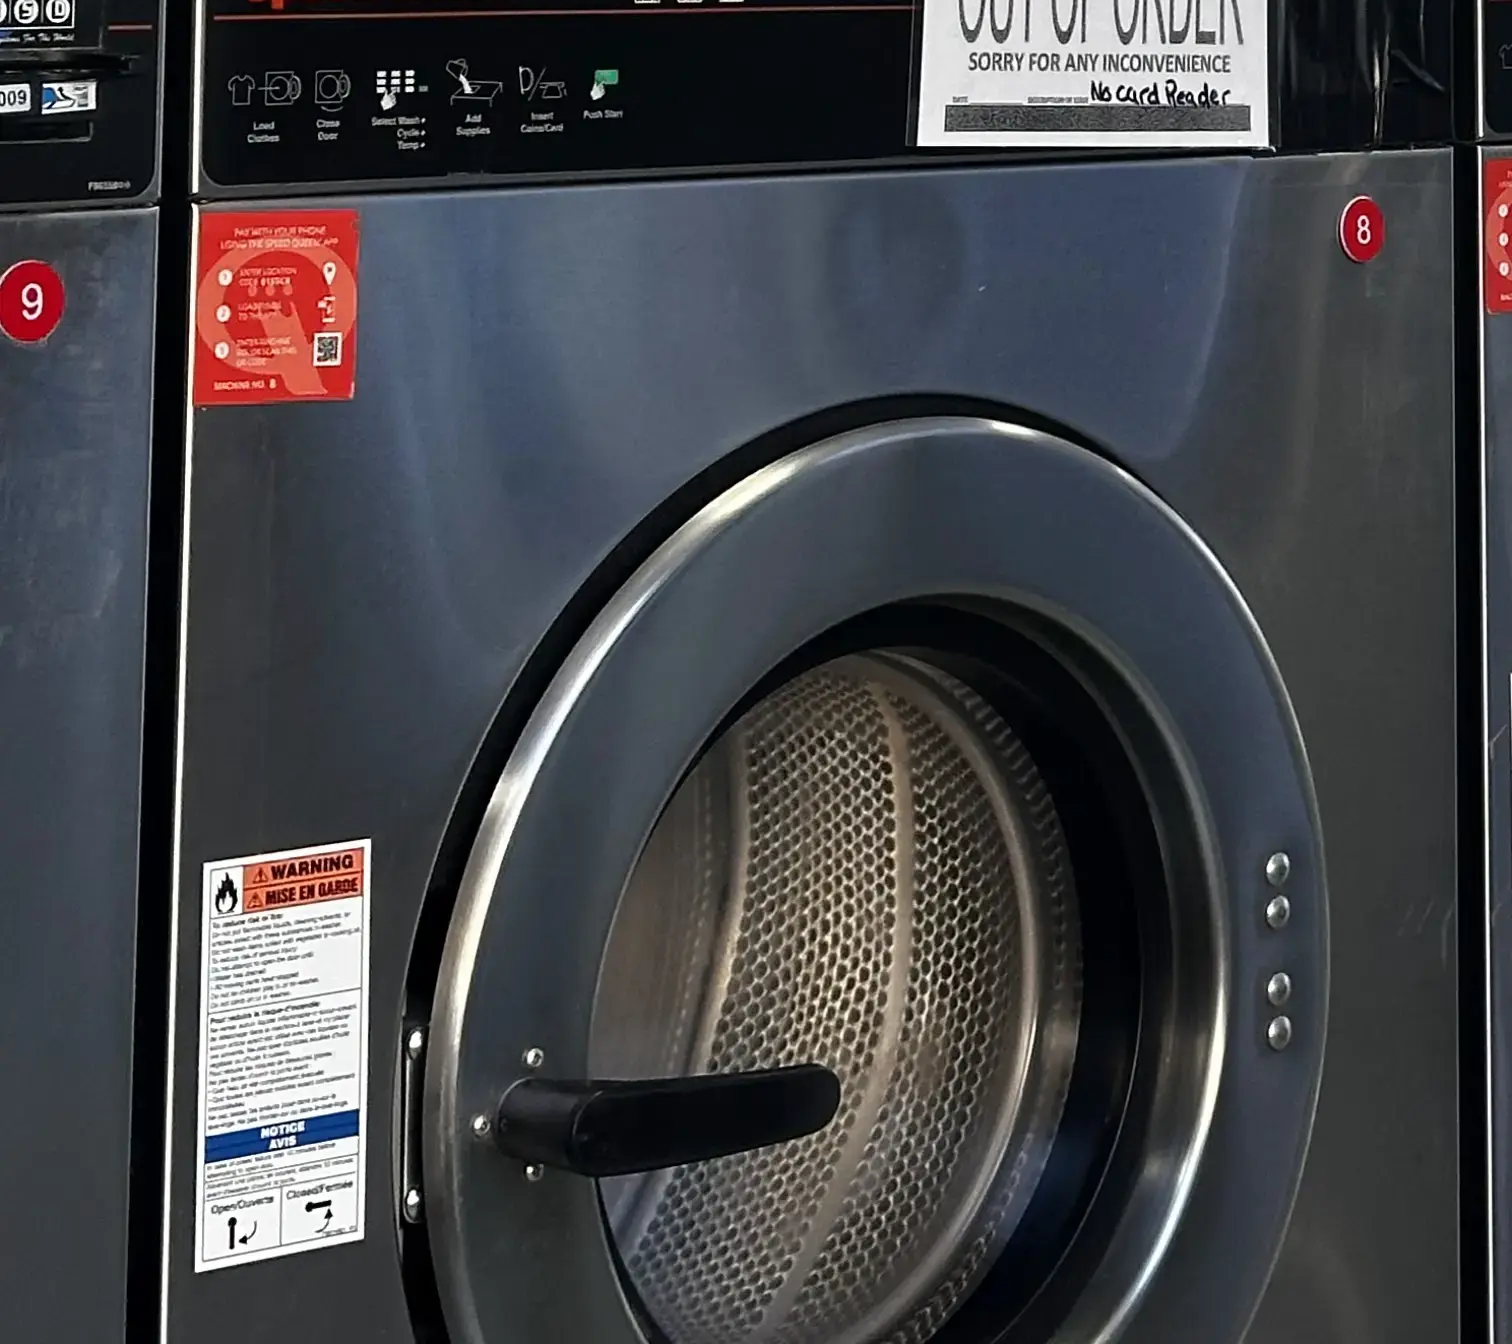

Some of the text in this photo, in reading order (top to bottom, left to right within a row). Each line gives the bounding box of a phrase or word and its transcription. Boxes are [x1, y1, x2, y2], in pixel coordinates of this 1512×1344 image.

[968, 51, 1231, 73] SORRY FOR ANY INCONVENIENCE
[1091, 79, 1230, 108] No card Reader
[1357, 215, 1371, 244] 8
[22, 283, 43, 320] 9
[271, 854, 354, 880] WARNING
[265, 877, 359, 905] MISE EN GARDE
[261, 1121, 306, 1139] NOTICE
[268, 1136, 297, 1150] AVIS
